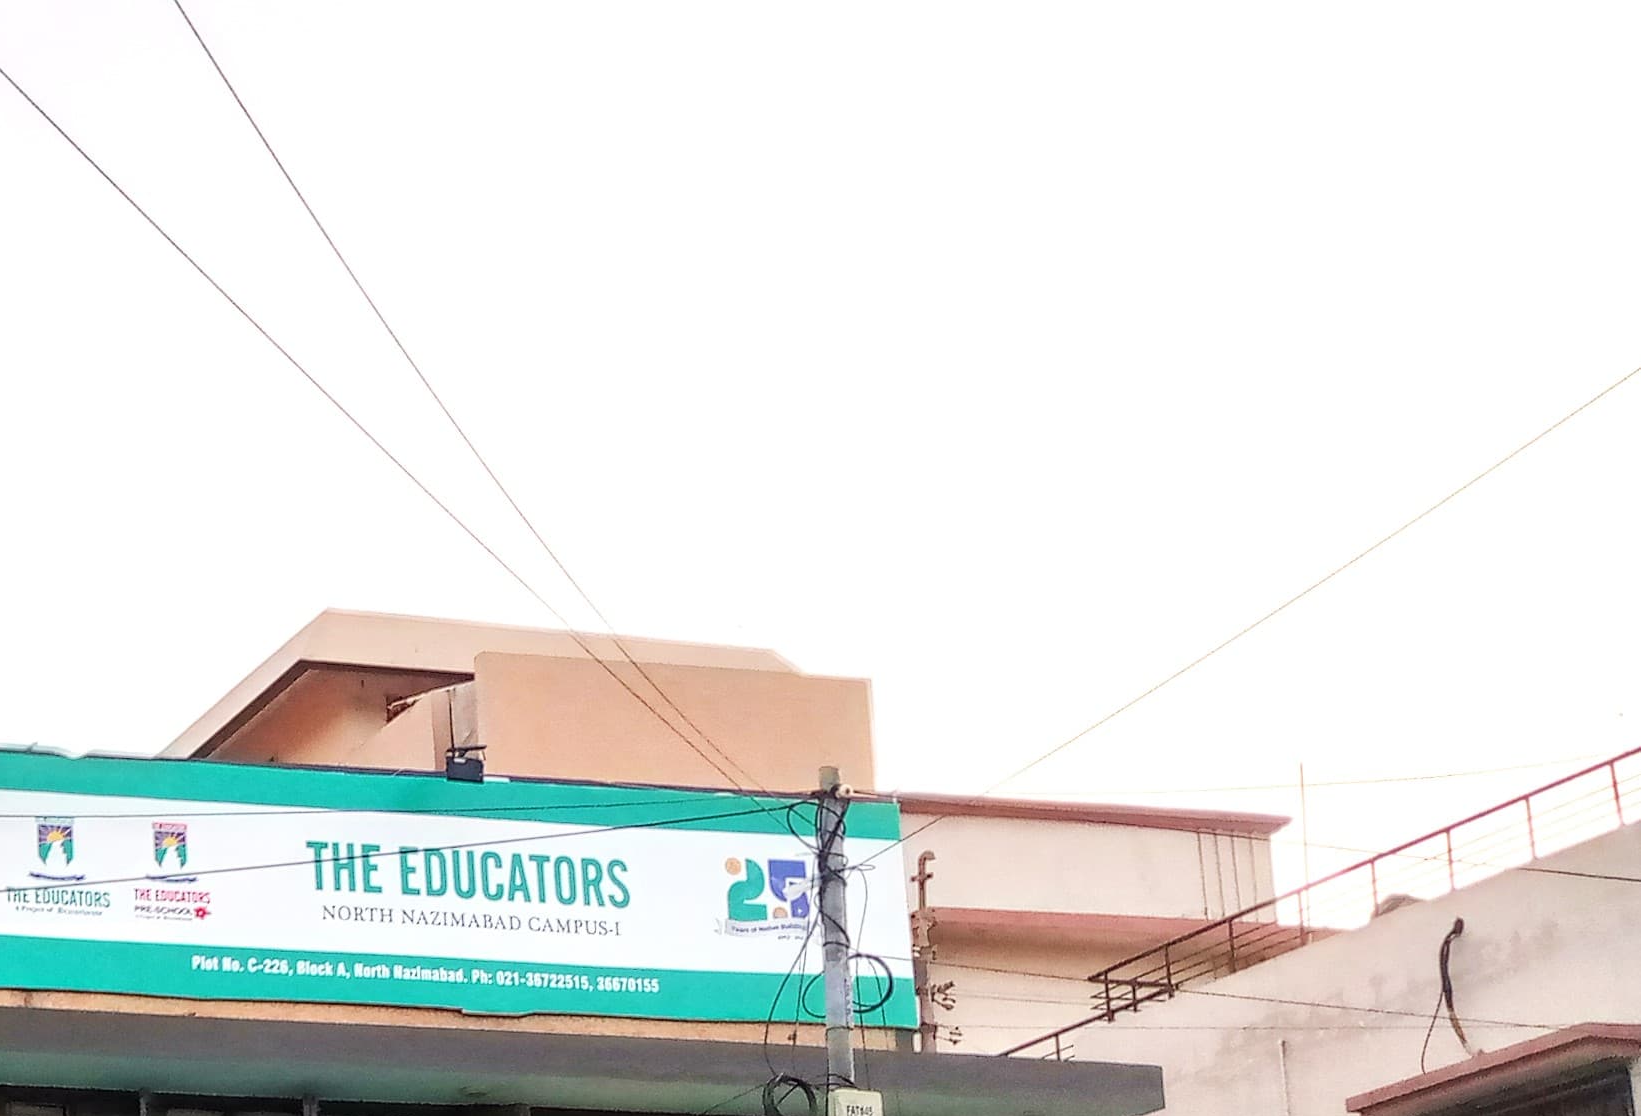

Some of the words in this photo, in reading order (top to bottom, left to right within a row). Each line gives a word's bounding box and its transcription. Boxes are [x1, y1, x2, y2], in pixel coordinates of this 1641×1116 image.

[306, 840, 382, 893] THE
[399, 846, 630, 908] EDUCATORS
[7, 886, 30, 903] THE
[35, 887, 111, 909] EDUCATORS
[134, 888, 152, 901] THE
[155, 889, 210, 905] EDUCATORS
[322, 905, 393, 923] NORTH
[401, 909, 521, 931] NAZIMABAD
[529, 917, 622, 937] CAMPUS-I
[191, 955, 219, 971] Plot
[222, 956, 244, 972] No.
[247, 958, 293, 976] C-226,
[296, 960, 333, 977] Block
[336, 962, 351, 979] A,
[354, 963, 390, 979] North
[393, 964, 468, 984] Nazimabad.
[471, 969, 492, 985] Ph:
